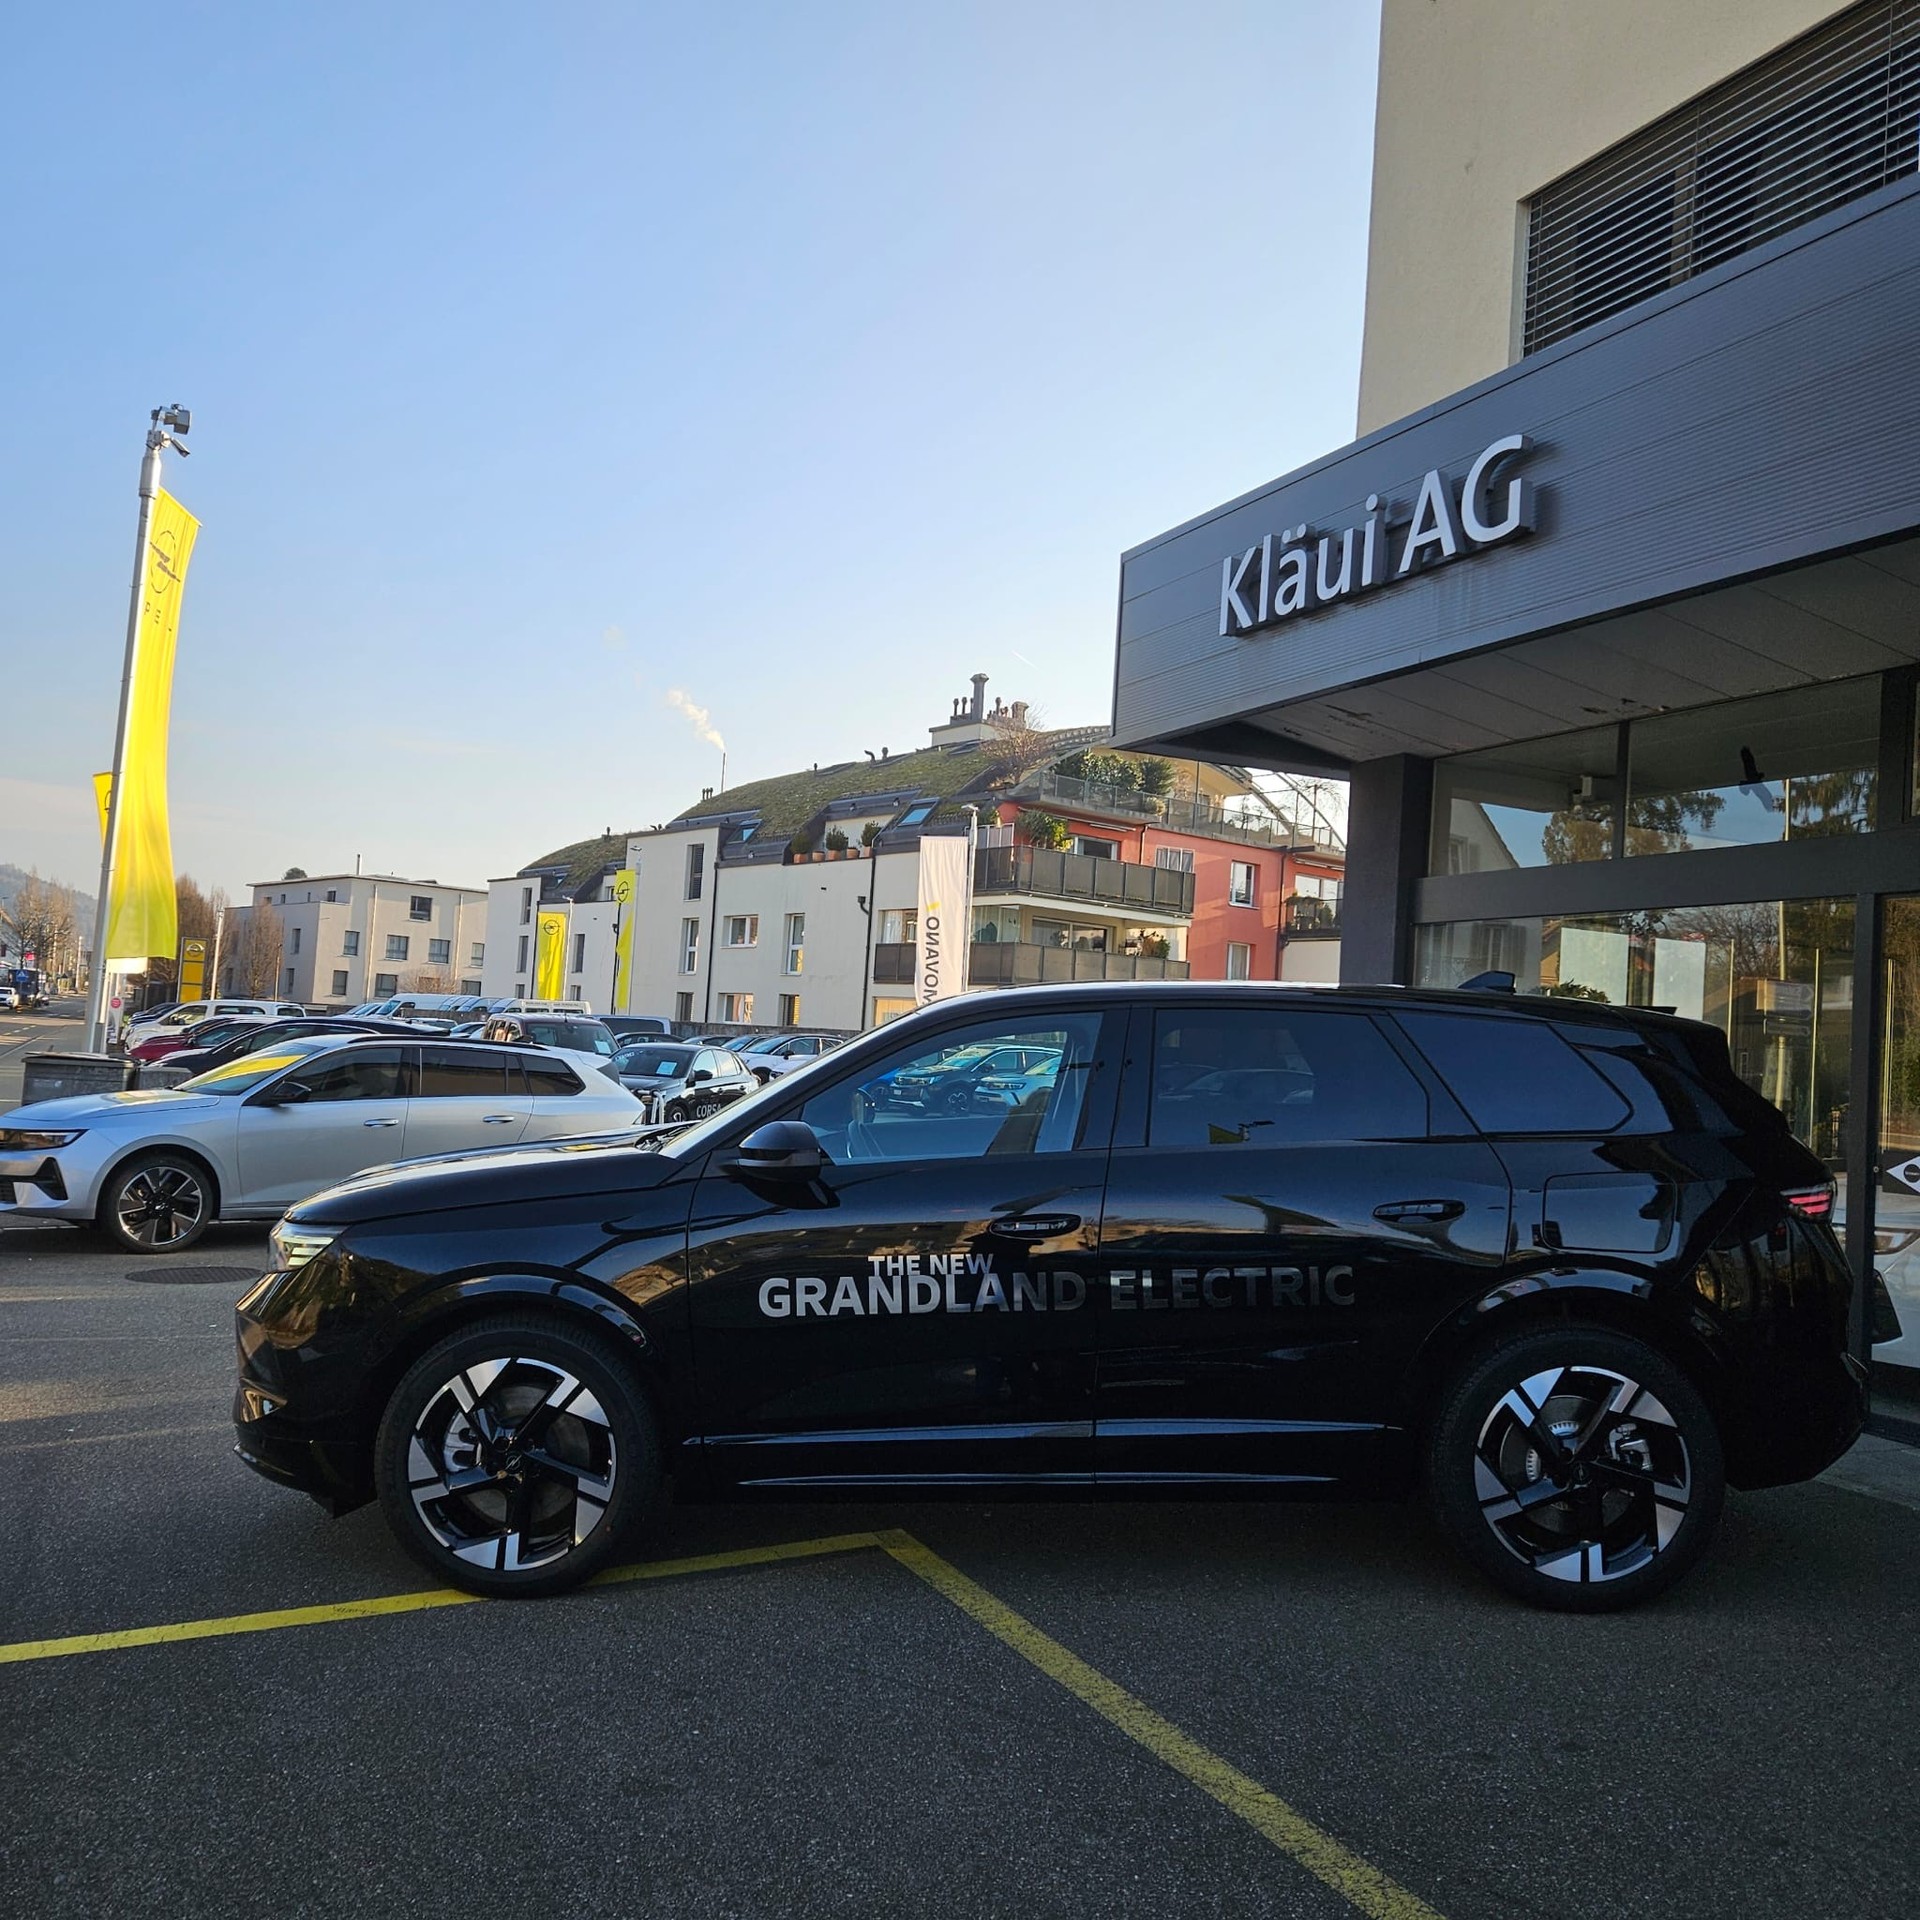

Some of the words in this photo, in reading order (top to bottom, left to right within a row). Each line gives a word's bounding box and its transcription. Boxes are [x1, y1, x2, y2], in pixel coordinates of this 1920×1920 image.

[1218, 493, 1381, 637] Kläui
[1397, 433, 1528, 575] AG
[758, 1270, 1087, 1319] GRANDLAND
[1109, 1264, 1356, 1311] ELECTRIC
[867, 1254, 921, 1277] THE
[929, 1252, 995, 1276] NEW
